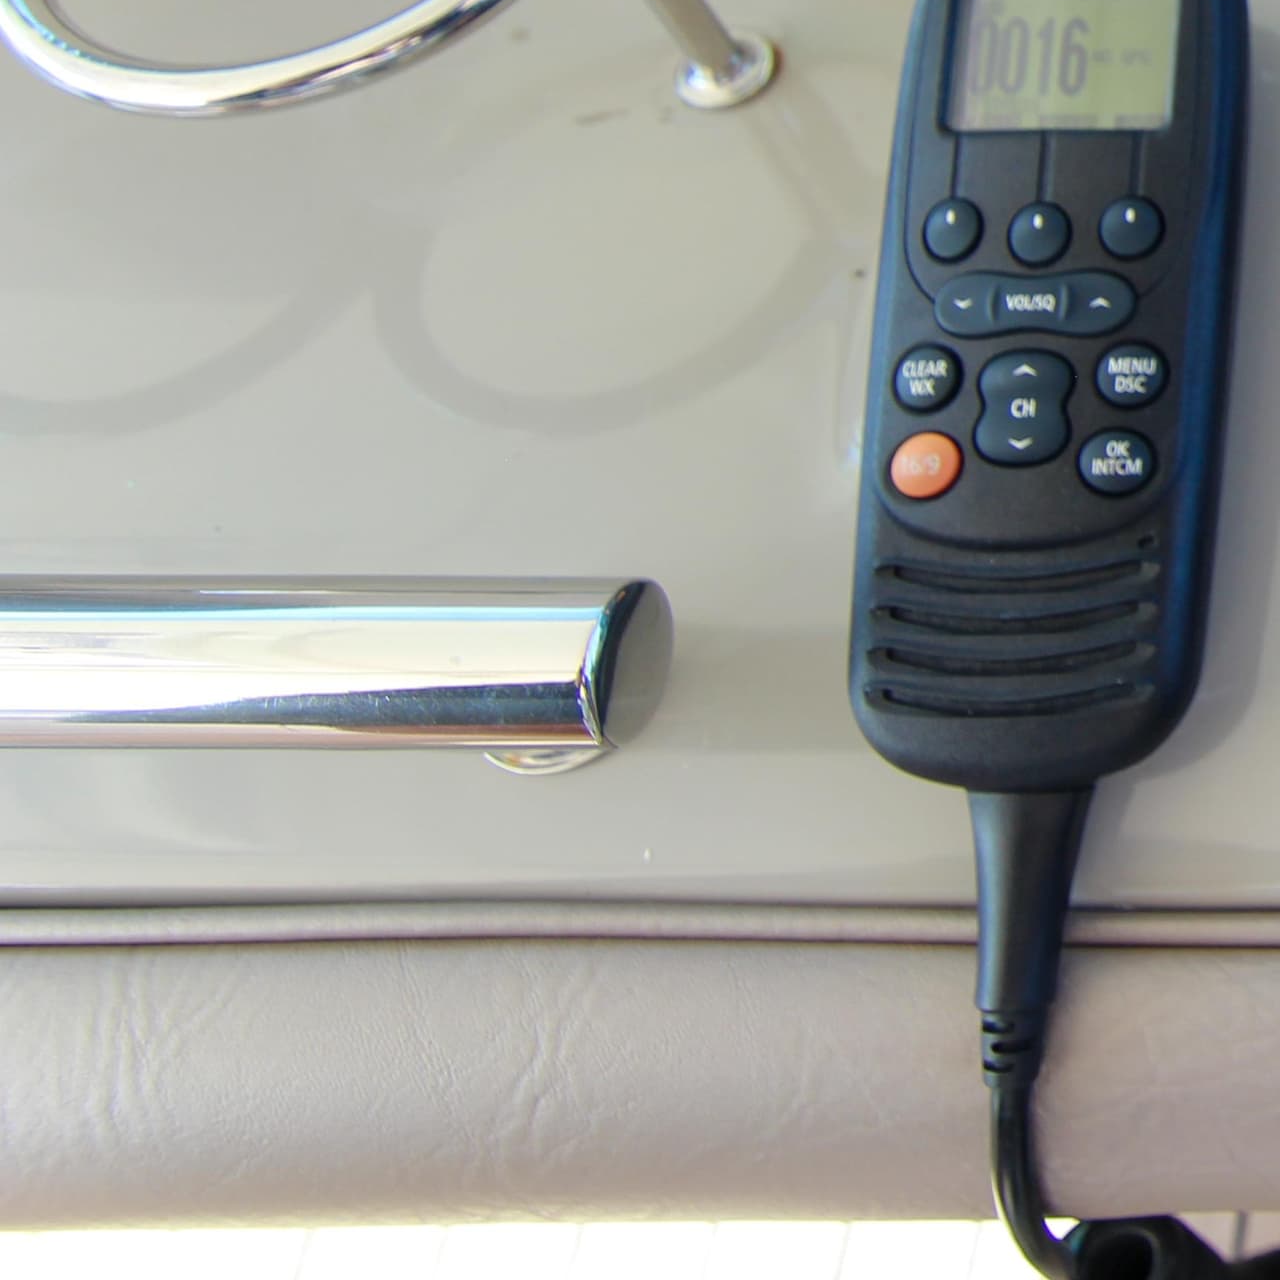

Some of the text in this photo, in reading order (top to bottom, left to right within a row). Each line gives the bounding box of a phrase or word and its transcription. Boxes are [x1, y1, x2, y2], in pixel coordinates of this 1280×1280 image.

[1006, 293, 1057, 313] VOL/SQ
[902, 358, 948, 380] CLEAR
[1108, 356, 1157, 376] MENU
[909, 378, 935, 398] WX
[1114, 375, 1147, 394] DSC
[1010, 398, 1037, 419] CH
[1106, 440, 1131, 458] OK
[1091, 456, 1144, 476] INTCM
